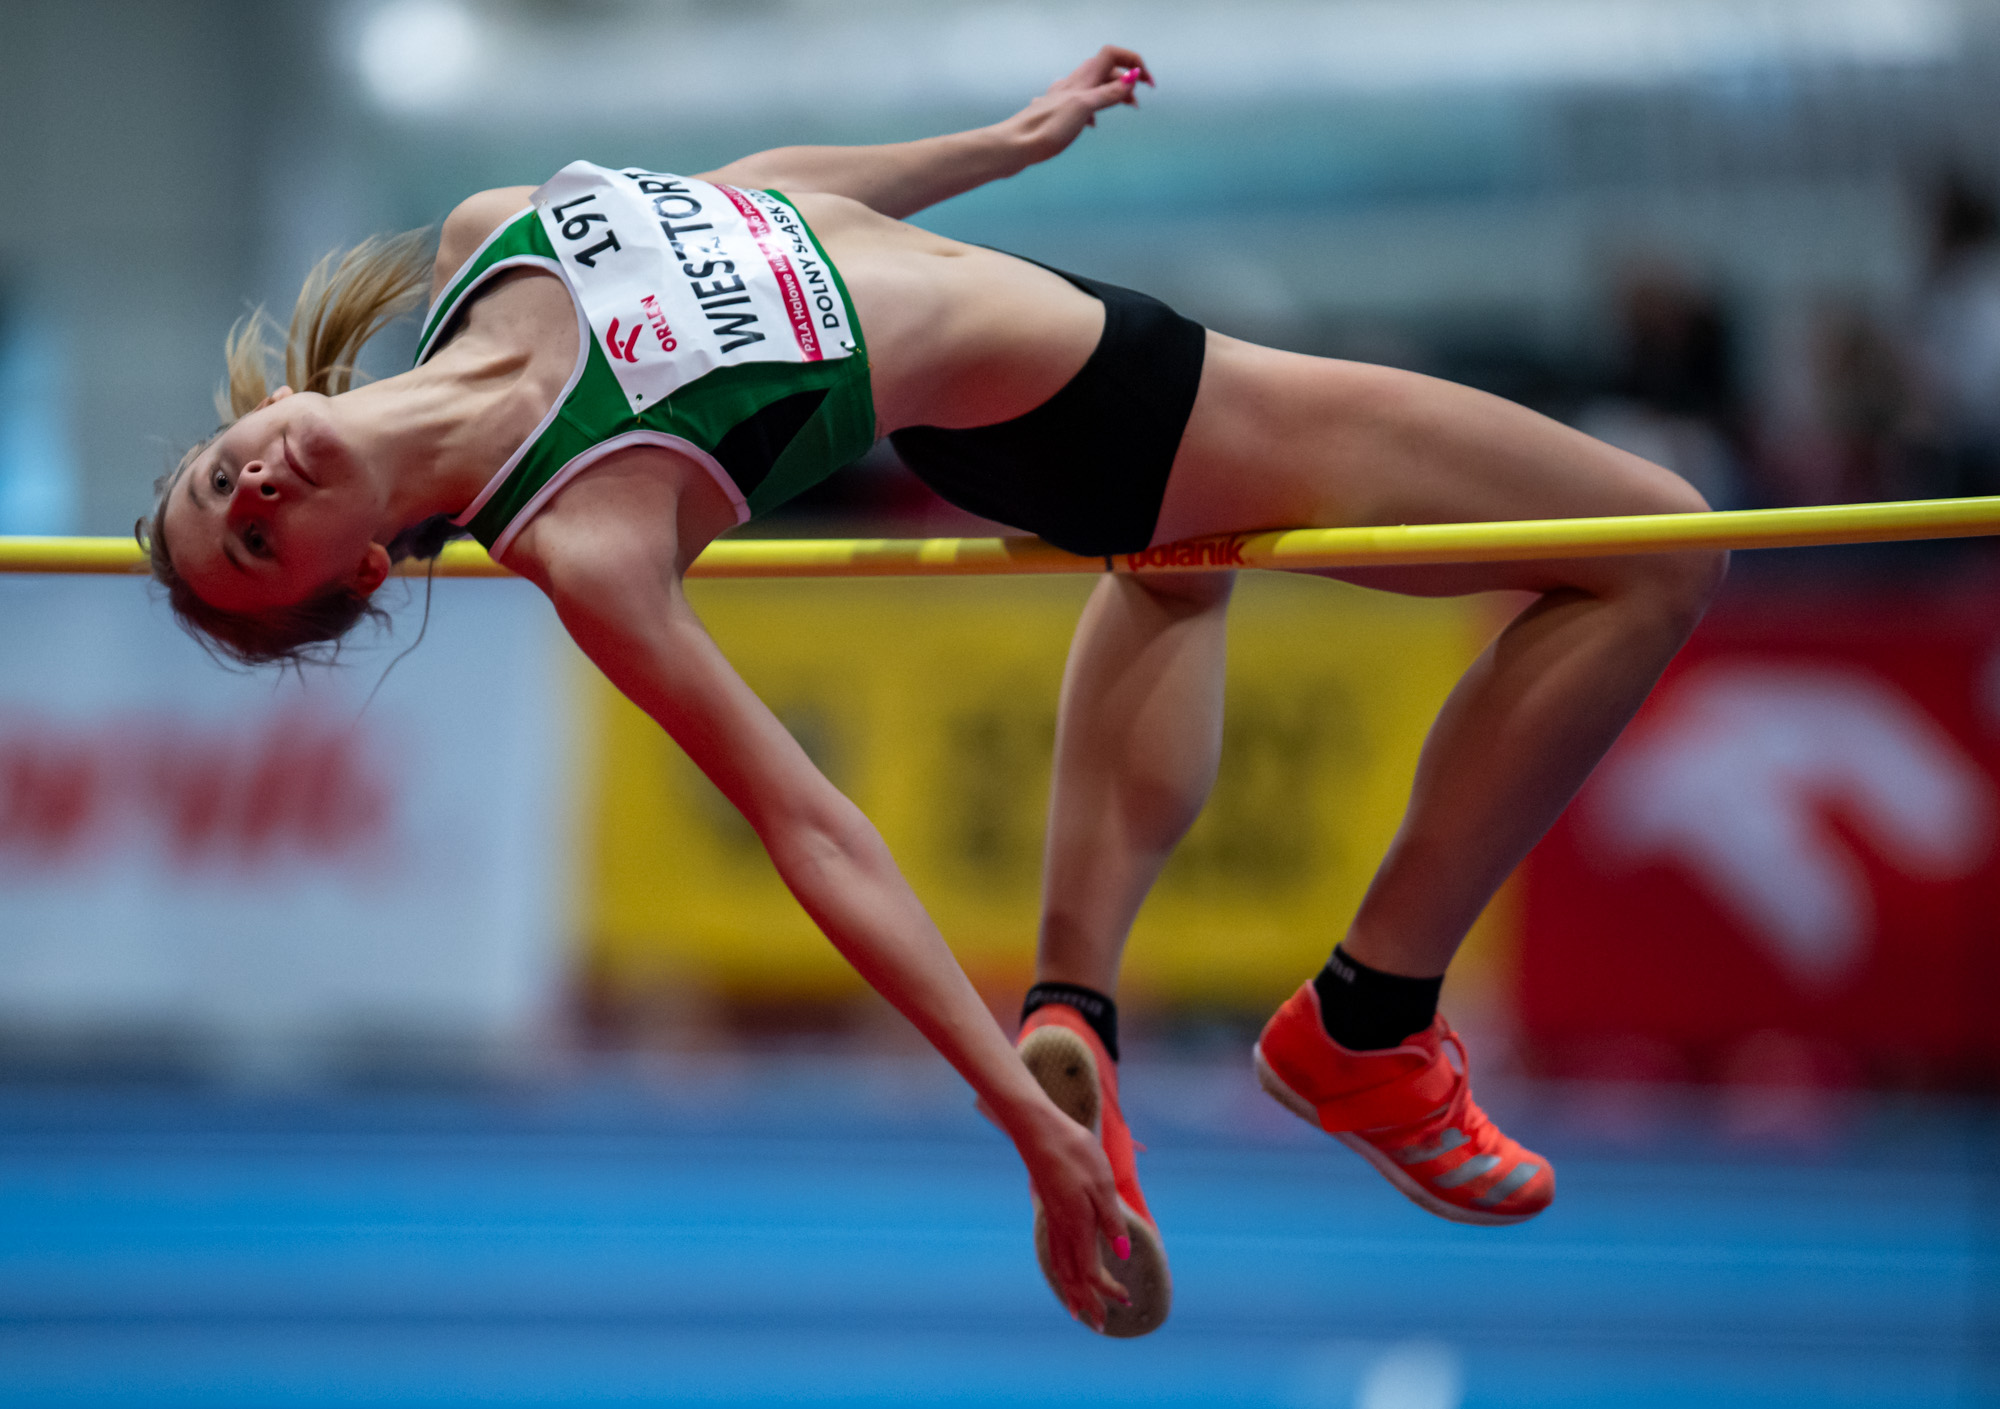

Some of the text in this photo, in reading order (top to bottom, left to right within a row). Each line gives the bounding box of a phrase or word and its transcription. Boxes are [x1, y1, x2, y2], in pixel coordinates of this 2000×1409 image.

[551, 194, 622, 268] 197
[782, 273, 806, 320] Halowe
[798, 258, 840, 329] DOLNY
[640, 294, 678, 352] ORLEN
[798, 321, 816, 352] PZLA
[1127, 534, 1247, 572] polanik
